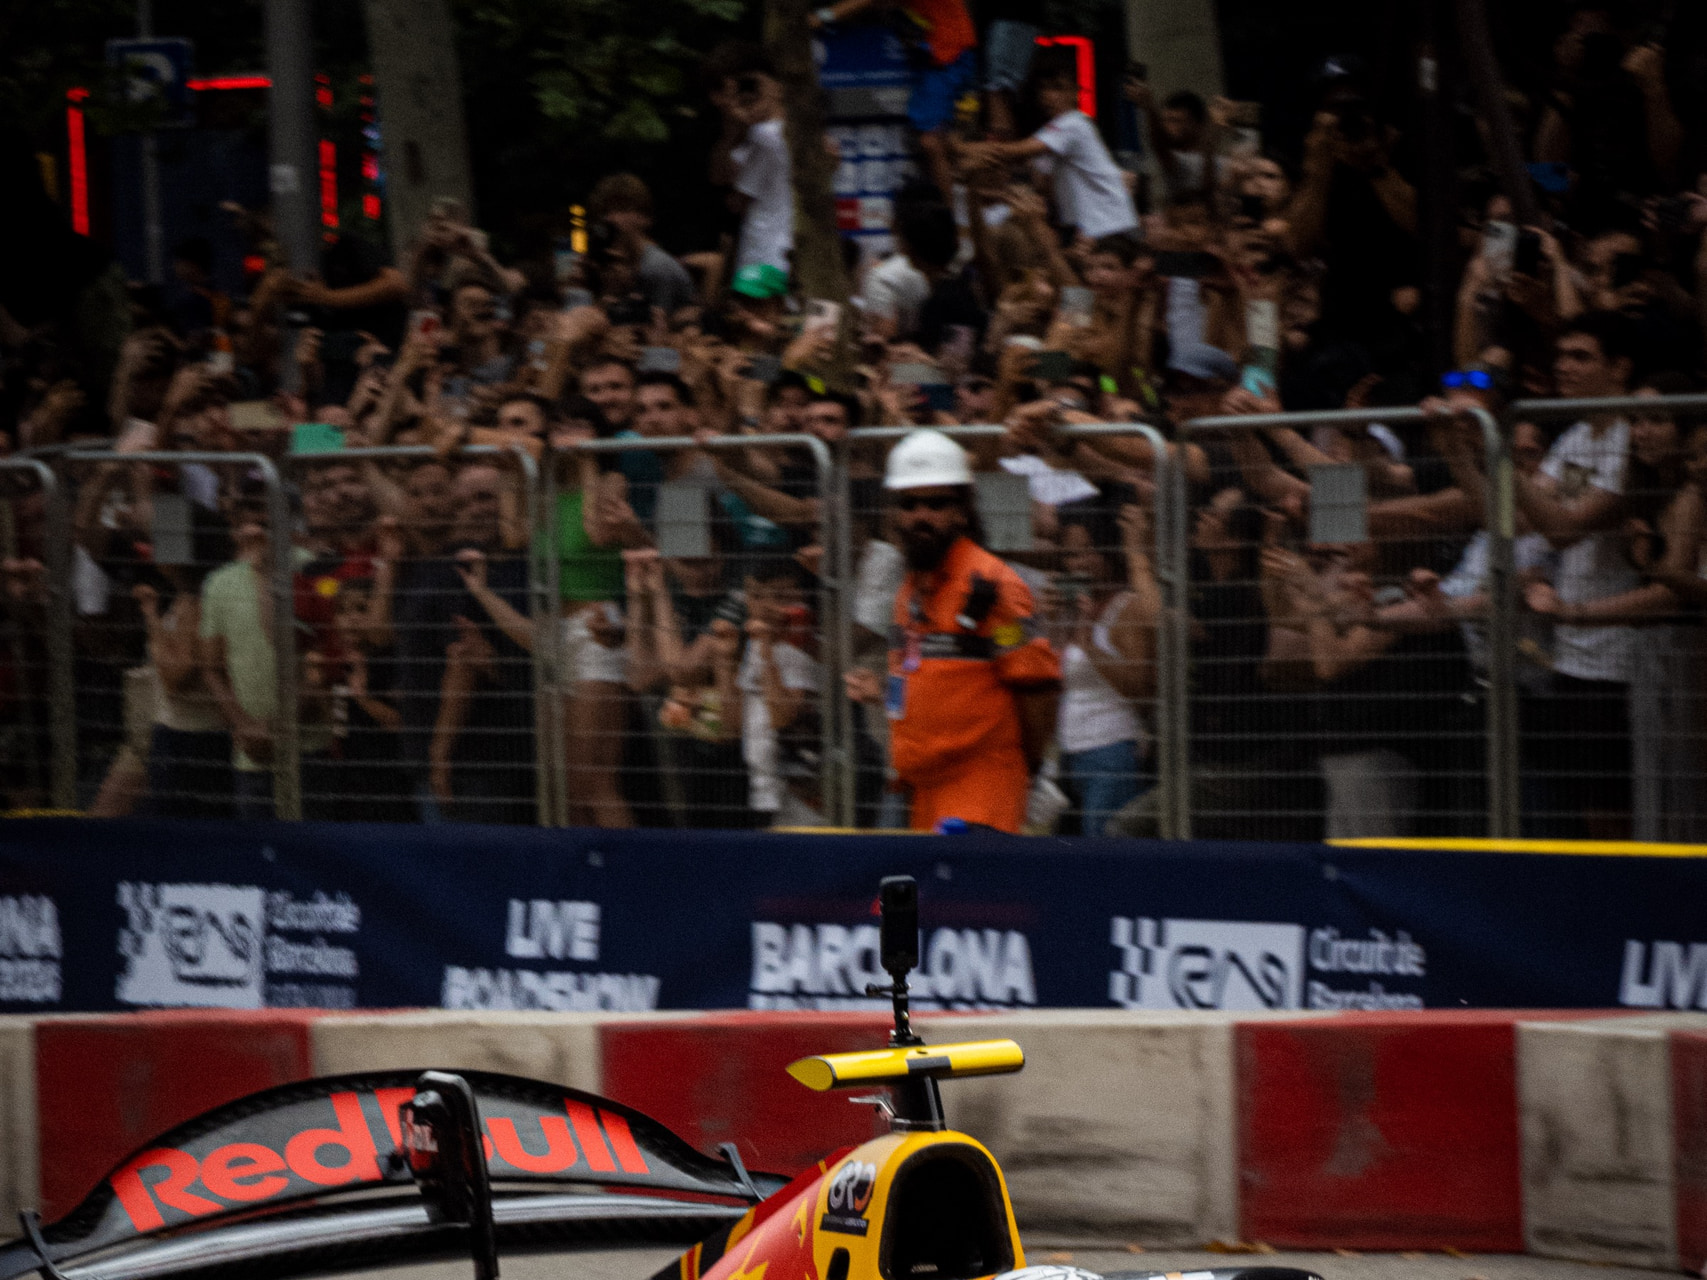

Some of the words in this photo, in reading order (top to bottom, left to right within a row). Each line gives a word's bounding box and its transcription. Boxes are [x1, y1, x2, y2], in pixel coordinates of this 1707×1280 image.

[505, 898, 600, 961] LIVE
[750, 921, 1037, 1004] BARCLONA
[110, 1091, 384, 1233] Red
